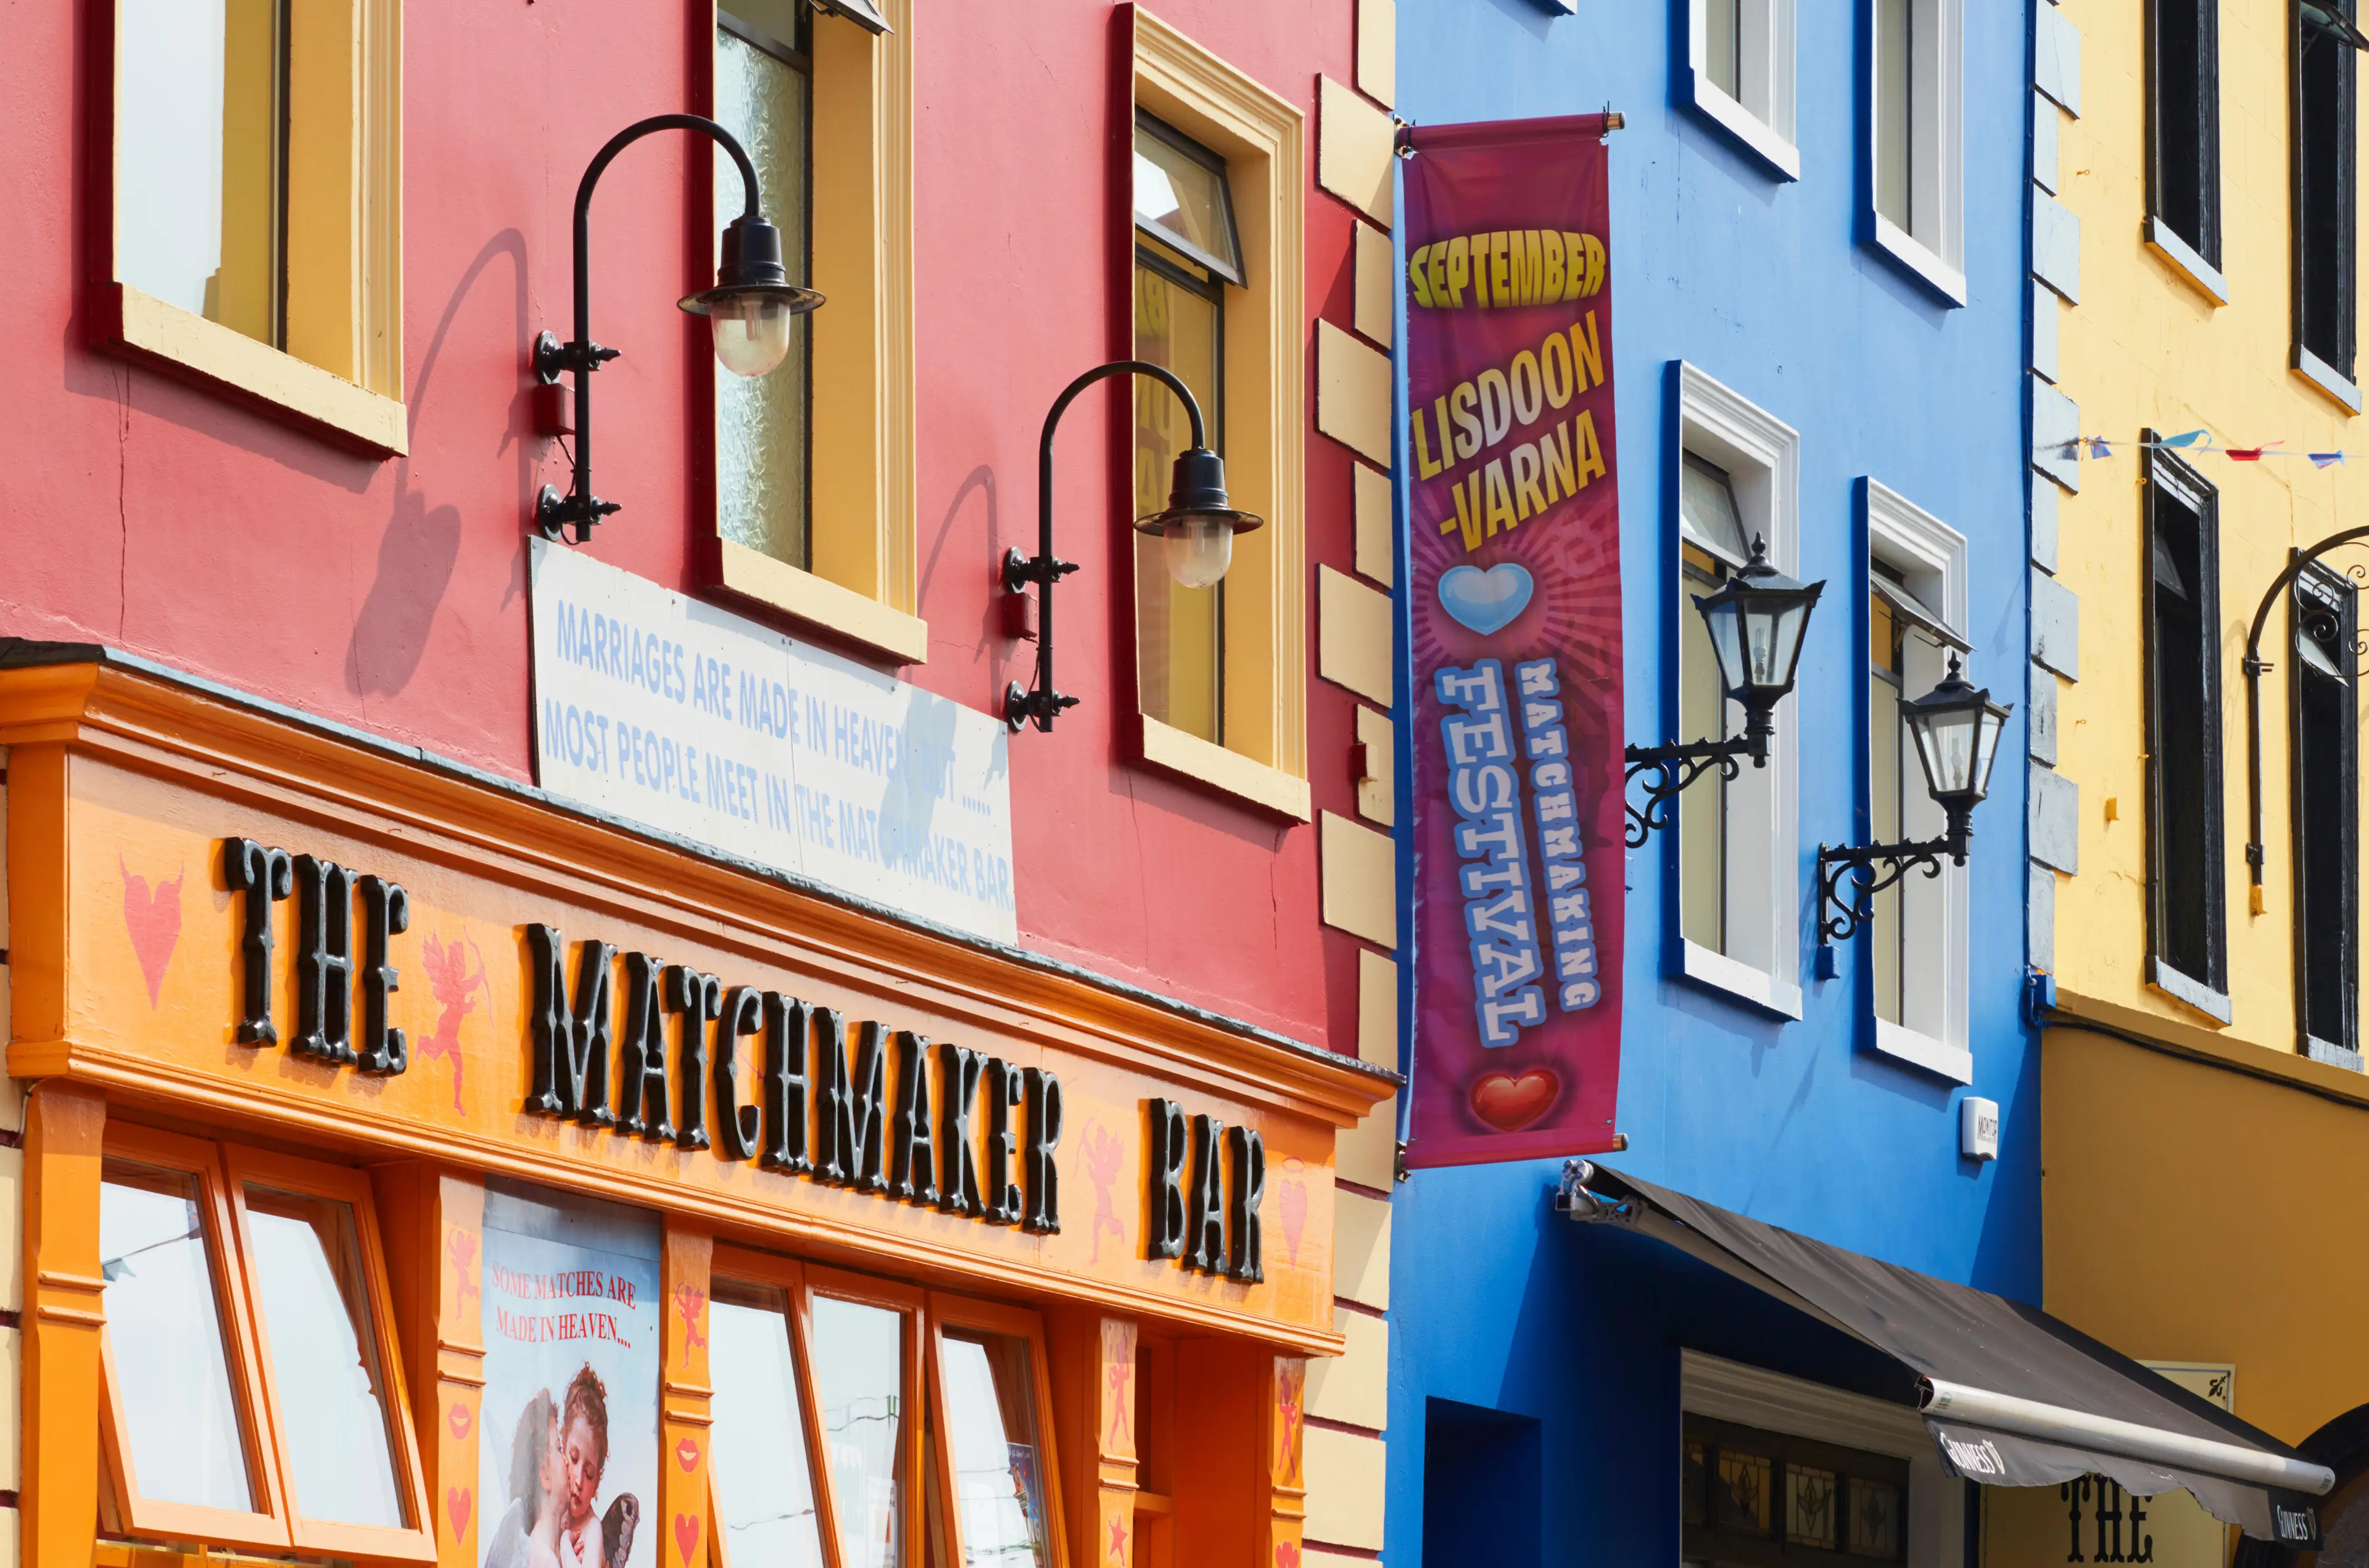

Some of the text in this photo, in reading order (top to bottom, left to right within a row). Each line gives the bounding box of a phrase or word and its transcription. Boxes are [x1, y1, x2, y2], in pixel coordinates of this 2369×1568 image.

[1410, 229, 1606, 308] SEPTEMBER
[1412, 309, 1605, 481] LISDOON
[557, 599, 685, 704] MARRIAGES
[693, 653, 732, 720] ARE
[740, 671, 801, 744] MADE
[805, 694, 827, 756] IN
[545, 697, 608, 775] MOST
[618, 722, 701, 804] PEOPLE
[706, 752, 758, 823] MEET
[765, 773, 790, 834] IN
[796, 784, 834, 849] THE
[839, 799, 970, 896] MATCHMAKER
[1439, 662, 1542, 1044] FESTIVAL
[1518, 661, 1597, 1009] MATCHMAKING
[225, 836, 1266, 1284] THE MATCHMAKER BAR
[492, 1260, 636, 1310] SOME MATCHES ARE
[496, 1305, 536, 1342] MADE
[540, 1316, 555, 1342] IN
[1940, 1432, 1995, 1474] GUINNESS
[2061, 1472, 2153, 1563] THE
[2277, 1504, 2308, 1540] GUINNESS
